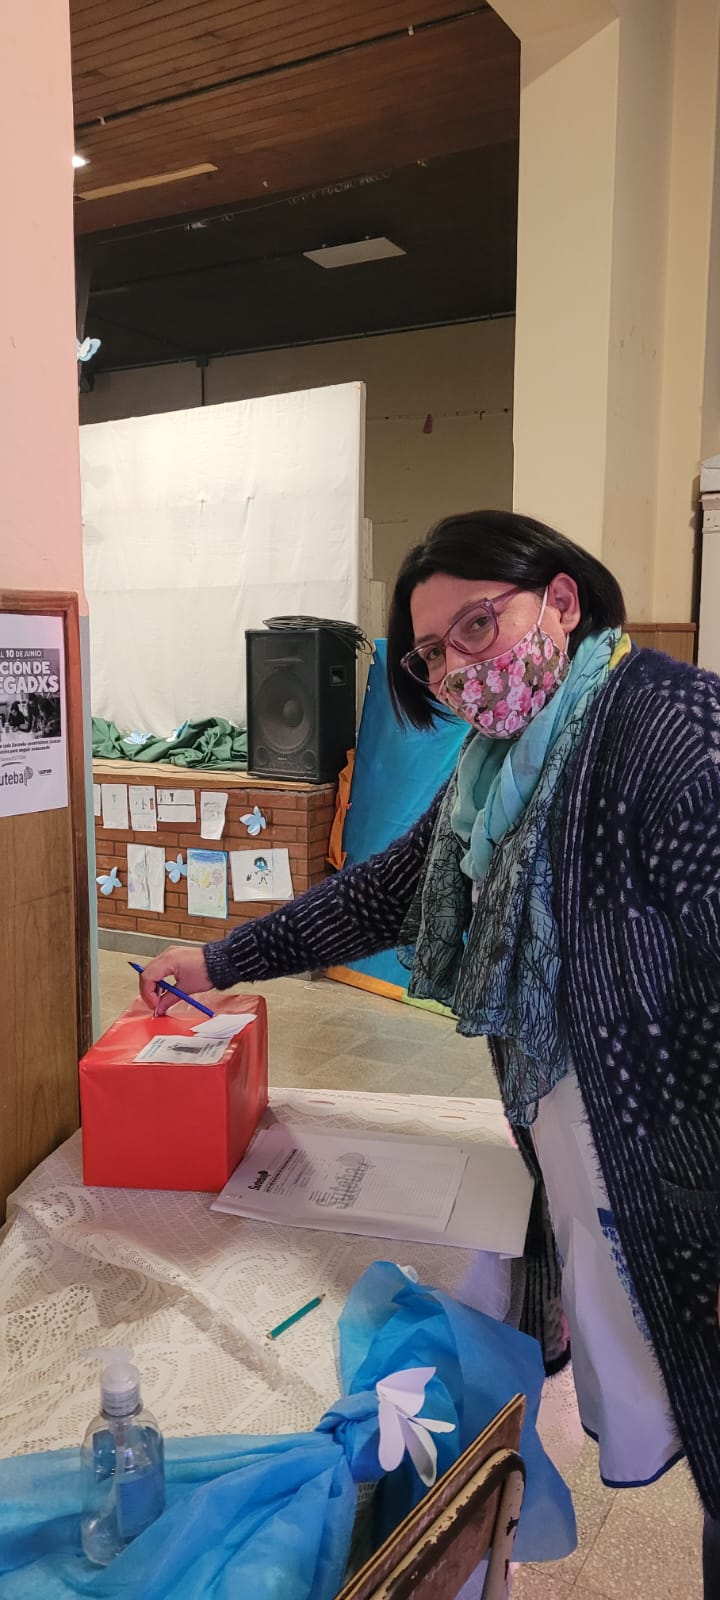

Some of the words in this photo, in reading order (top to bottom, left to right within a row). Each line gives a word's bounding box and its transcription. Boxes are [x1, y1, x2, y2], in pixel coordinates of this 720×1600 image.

[6, 649, 14, 658] 10
[15, 650, 24, 658] DE
[24, 649, 42, 657] JUNIO
[0, 658, 31, 675] CIÓN
[32, 661, 51, 675] DE
